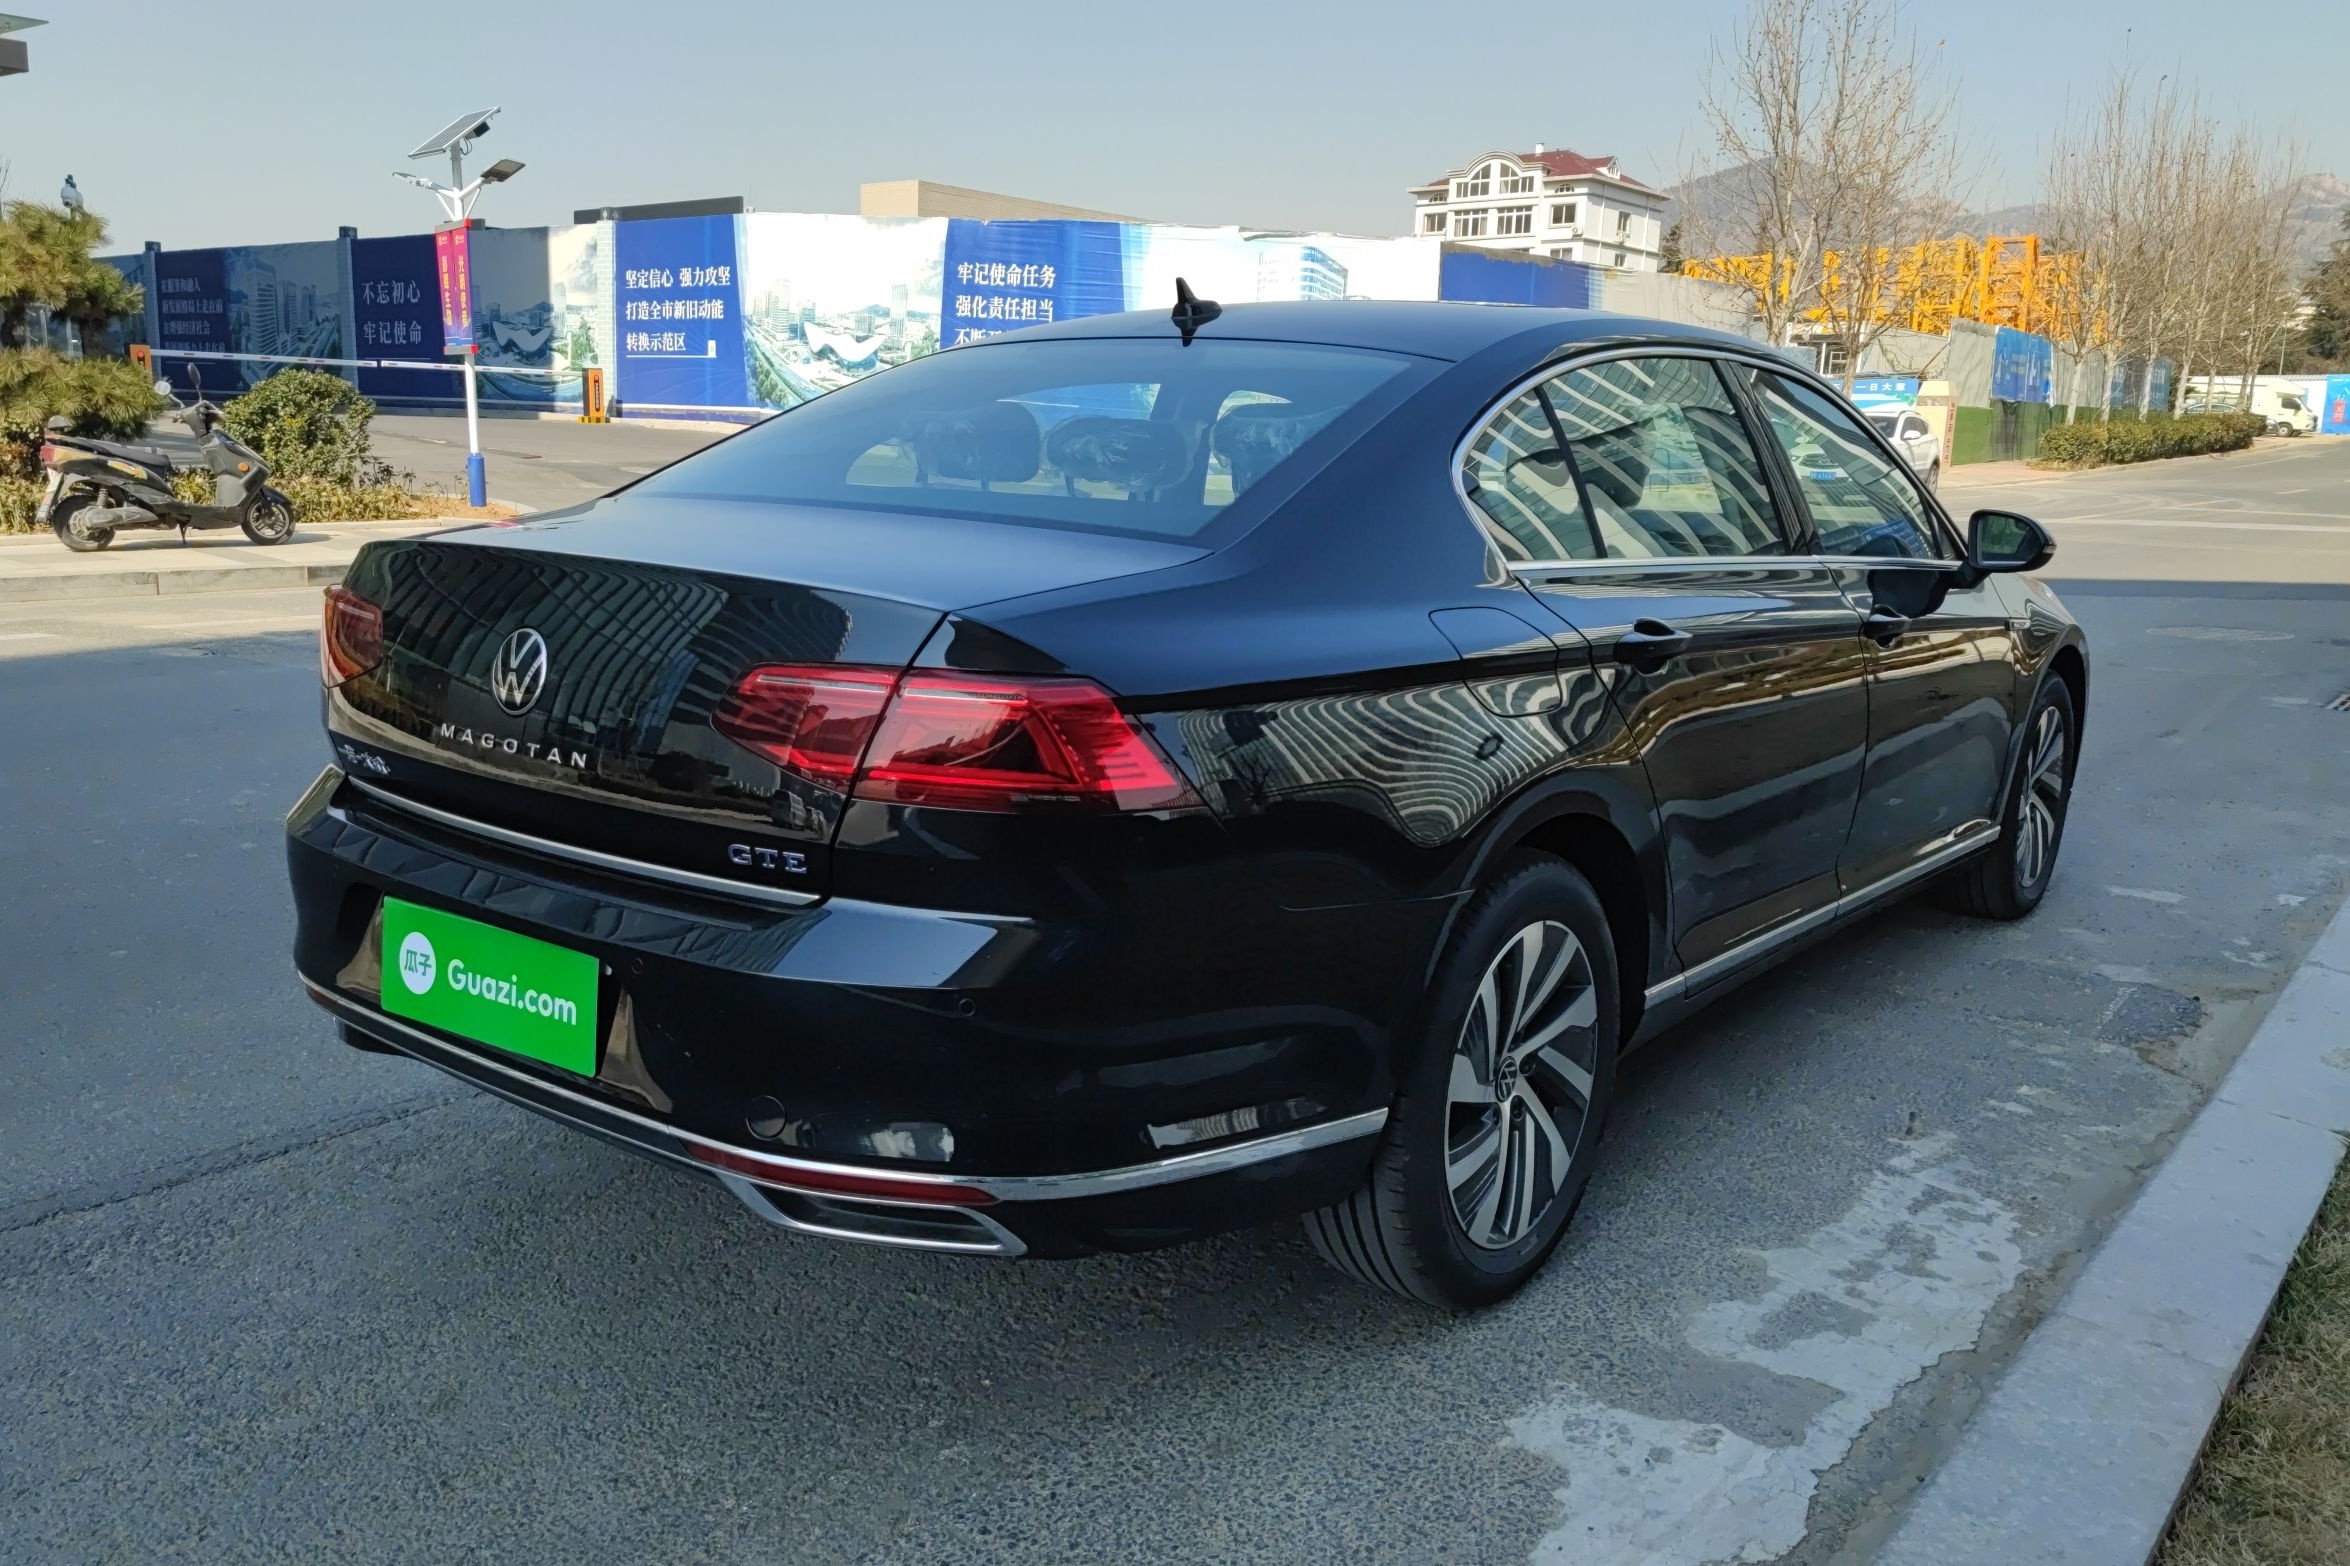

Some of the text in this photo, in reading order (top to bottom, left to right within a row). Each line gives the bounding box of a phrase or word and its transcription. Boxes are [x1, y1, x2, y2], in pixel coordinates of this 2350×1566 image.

[625, 265, 731, 289] 坚定信心 强力攻坚
[957, 261, 1057, 288] 牢记使命任务
[361, 279, 421, 305] 不忘初心
[626, 299, 724, 320] 打造全市新旧动能
[955, 294, 1054, 322] 强化责任担当
[363, 320, 422, 345] 牢记使命
[626, 331, 687, 352] 转换示范区
[440, 722, 588, 769] MAGOTAN
[728, 843, 808, 874] GTE
[404, 948, 433, 977] 瓜子
[447, 958, 578, 1026] Guazi.com
